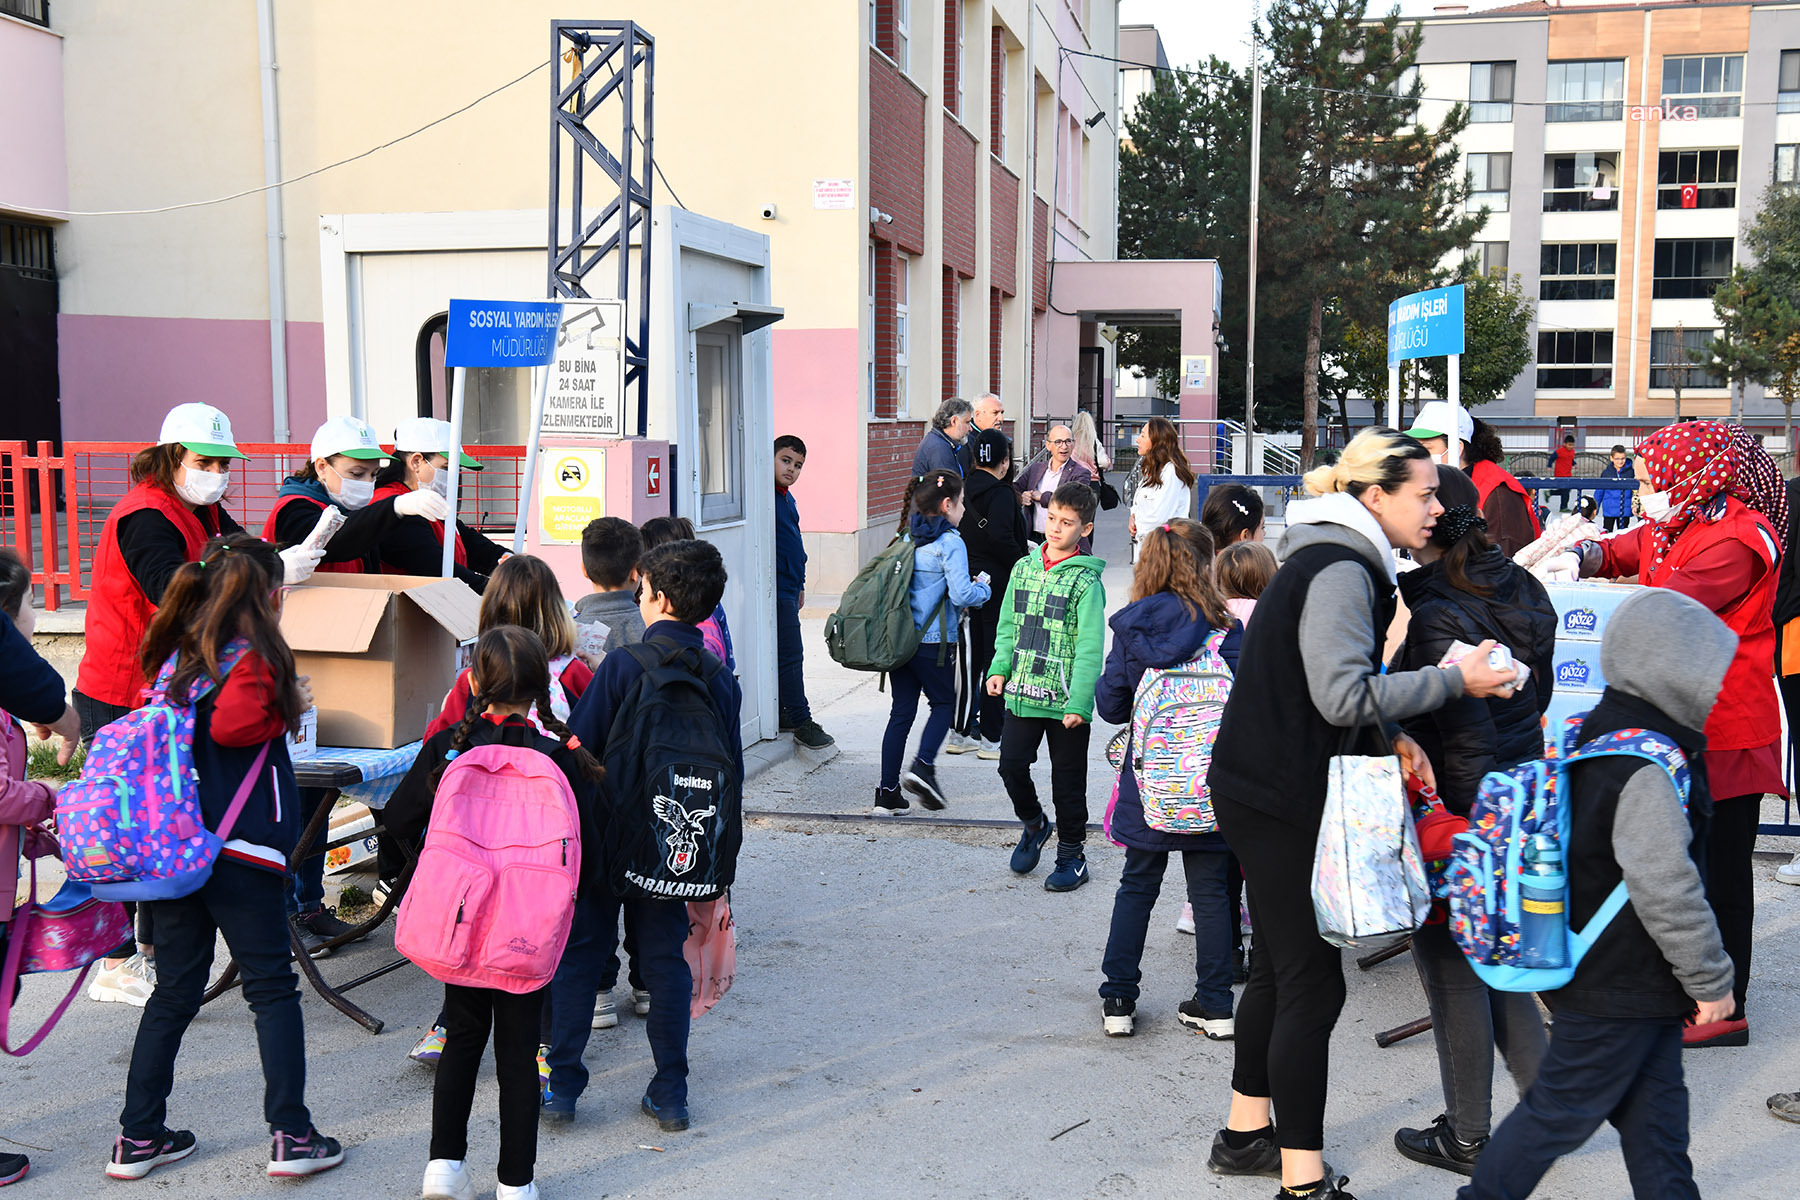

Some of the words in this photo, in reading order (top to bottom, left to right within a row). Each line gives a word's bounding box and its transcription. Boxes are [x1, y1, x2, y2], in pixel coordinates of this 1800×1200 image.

[1421, 293, 1448, 322] İŞLERİ
[469, 310, 512, 328] SOSYAL
[514, 311, 544, 328] YARDIM
[1390, 325, 1429, 353] DÜRLÜĞÜ
[559, 360, 571, 372] BU
[575, 358, 596, 373] BİNA
[559, 378, 569, 390] 24
[572, 378, 596, 391] SAAT
[550, 396, 587, 409] KAMERA
[591, 394, 604, 409] İLE
[555, 523, 588, 531] GİREME
[1567, 611, 1594, 628] göze
[1560, 664, 1586, 680] göze
[673, 774, 712, 790] Beşiktaş
[367, 835, 379, 850] gö
[624, 870, 719, 897] KARAKARTAL
